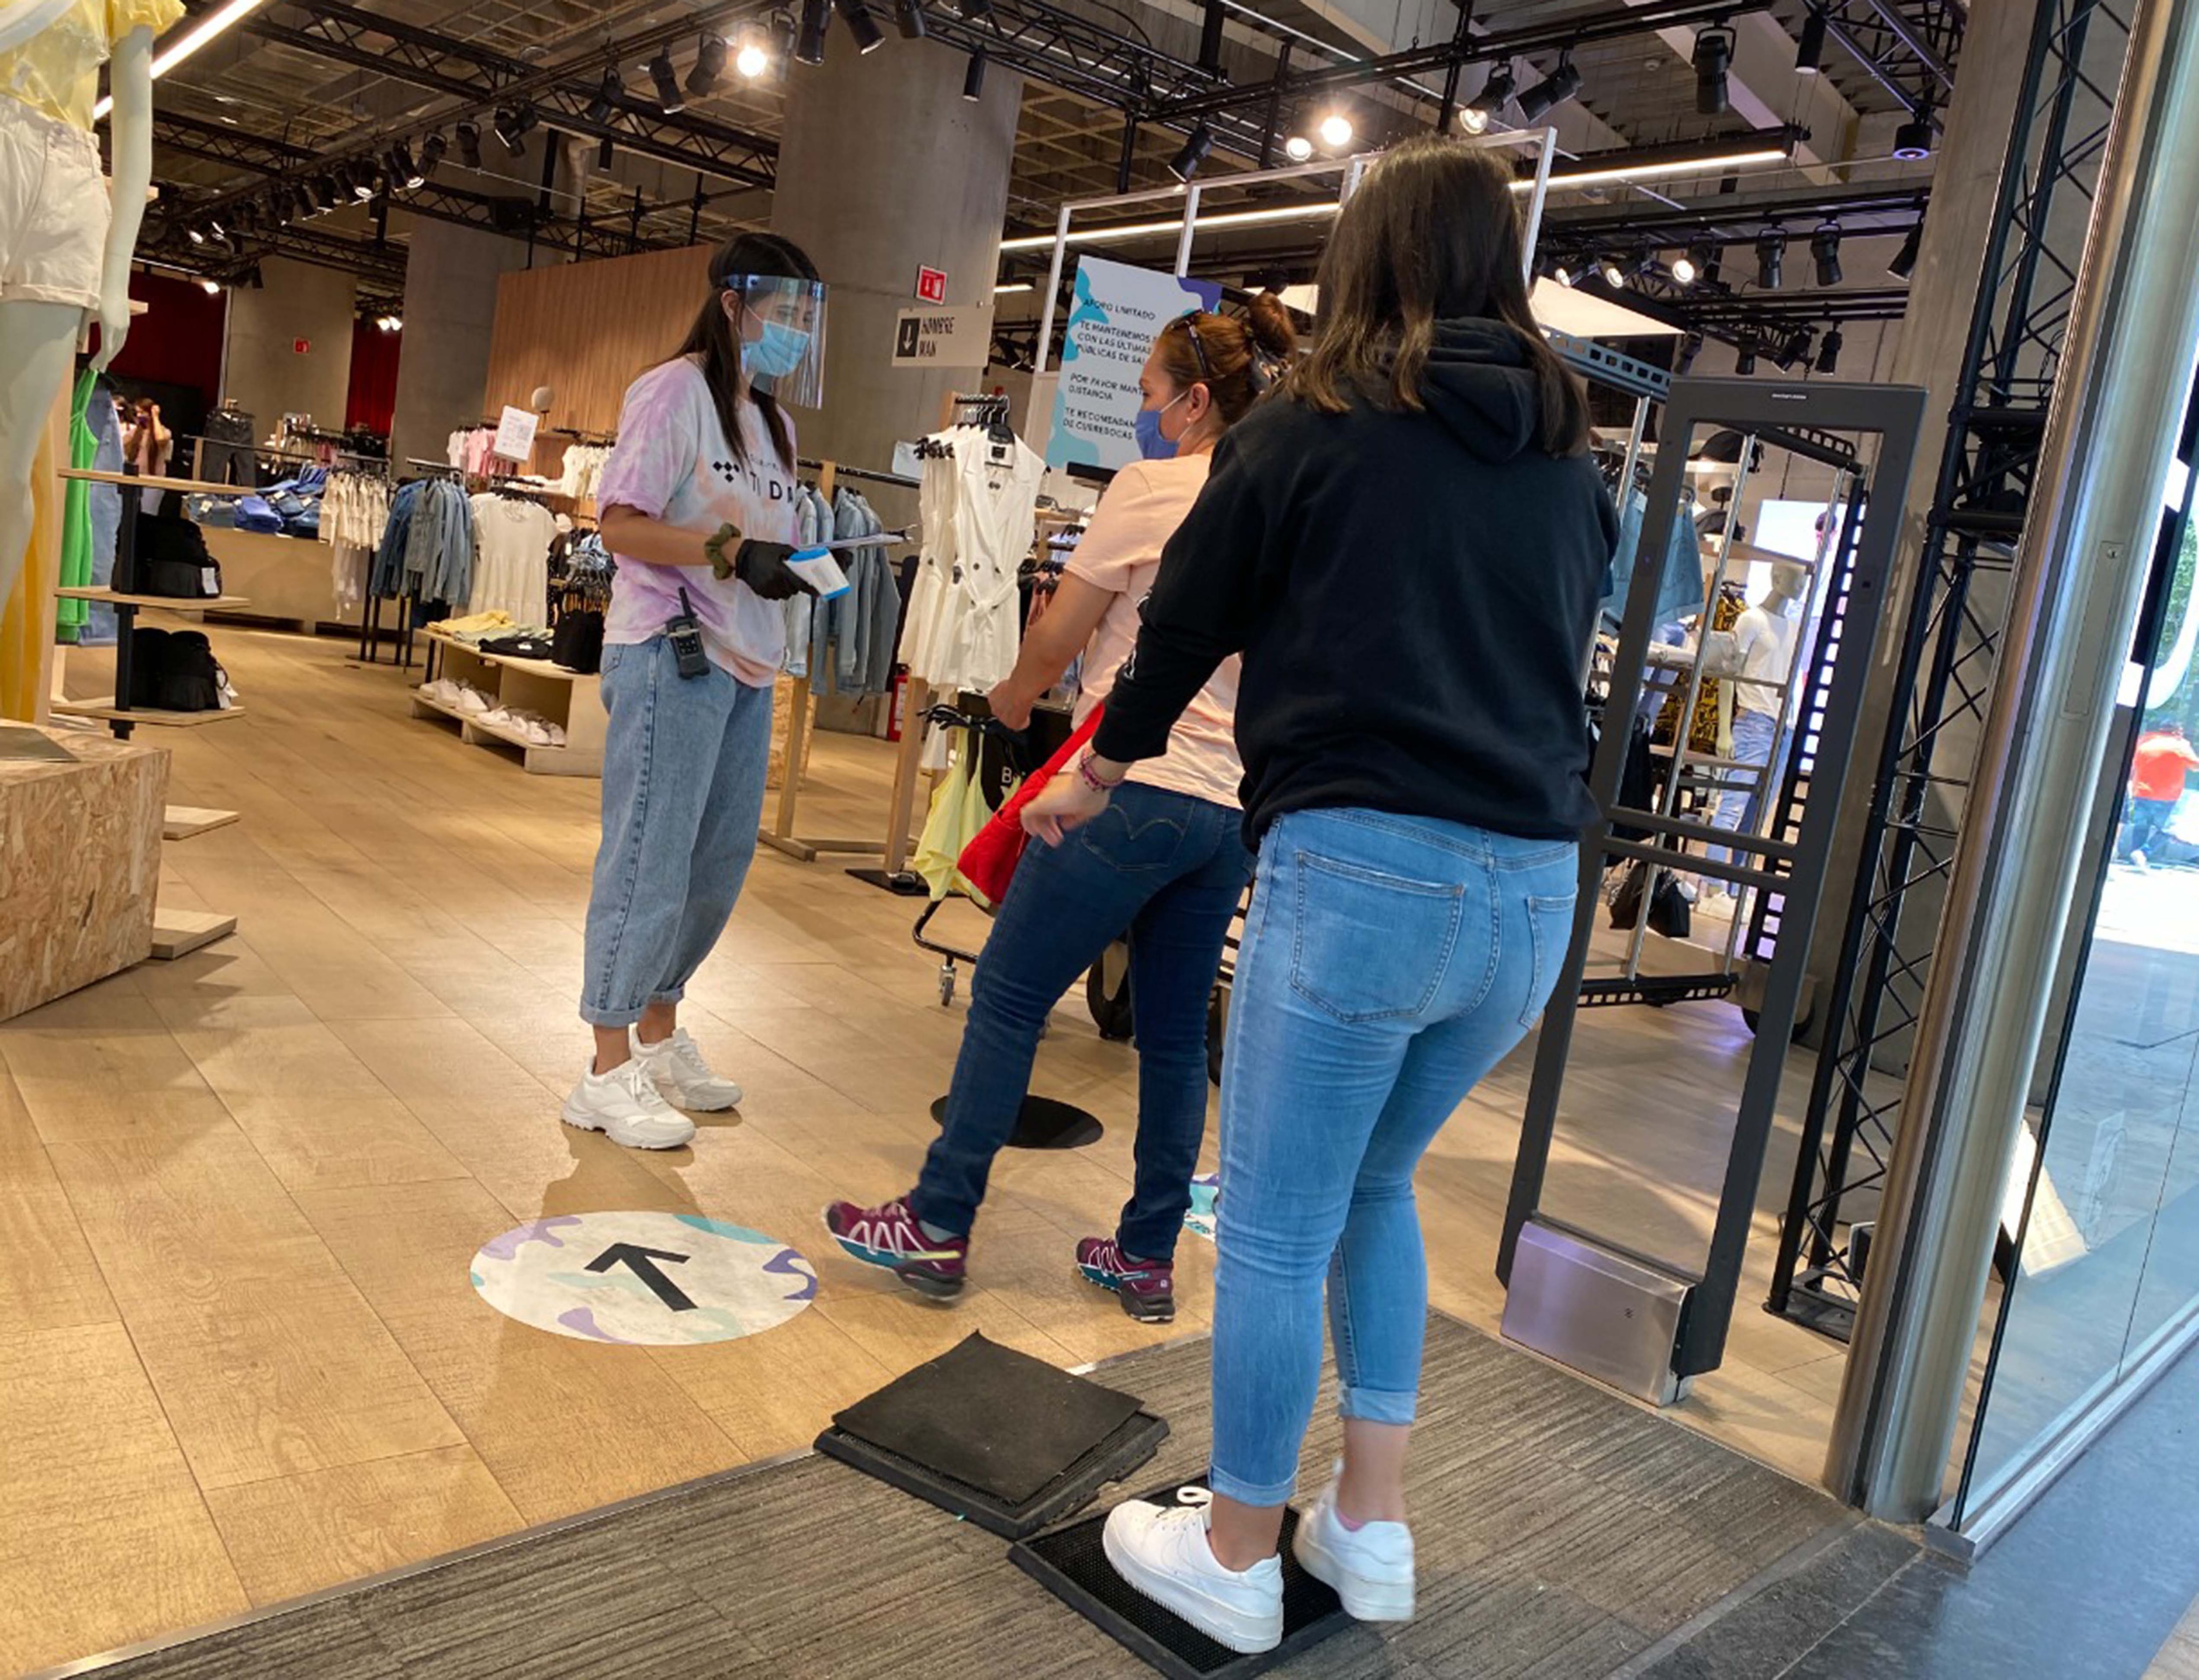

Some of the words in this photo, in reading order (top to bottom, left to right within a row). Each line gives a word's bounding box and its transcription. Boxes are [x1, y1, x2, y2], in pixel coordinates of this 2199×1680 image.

[1115, 305, 1156, 320] LIMITADO
[1081, 320, 1090, 330] TE
[1092, 323, 1150, 343] MANTENEMOS
[1078, 332, 1097, 343] CON
[1099, 337, 1115, 347] LAS
[1118, 353, 1129, 363] DE
[1070, 373, 1088, 384] POR
[1091, 377, 1118, 389] FAVOR
[1068, 385, 1113, 401] DISTANCIA
[1066, 407, 1075, 416] TE
[1063, 418, 1074, 428] DE
